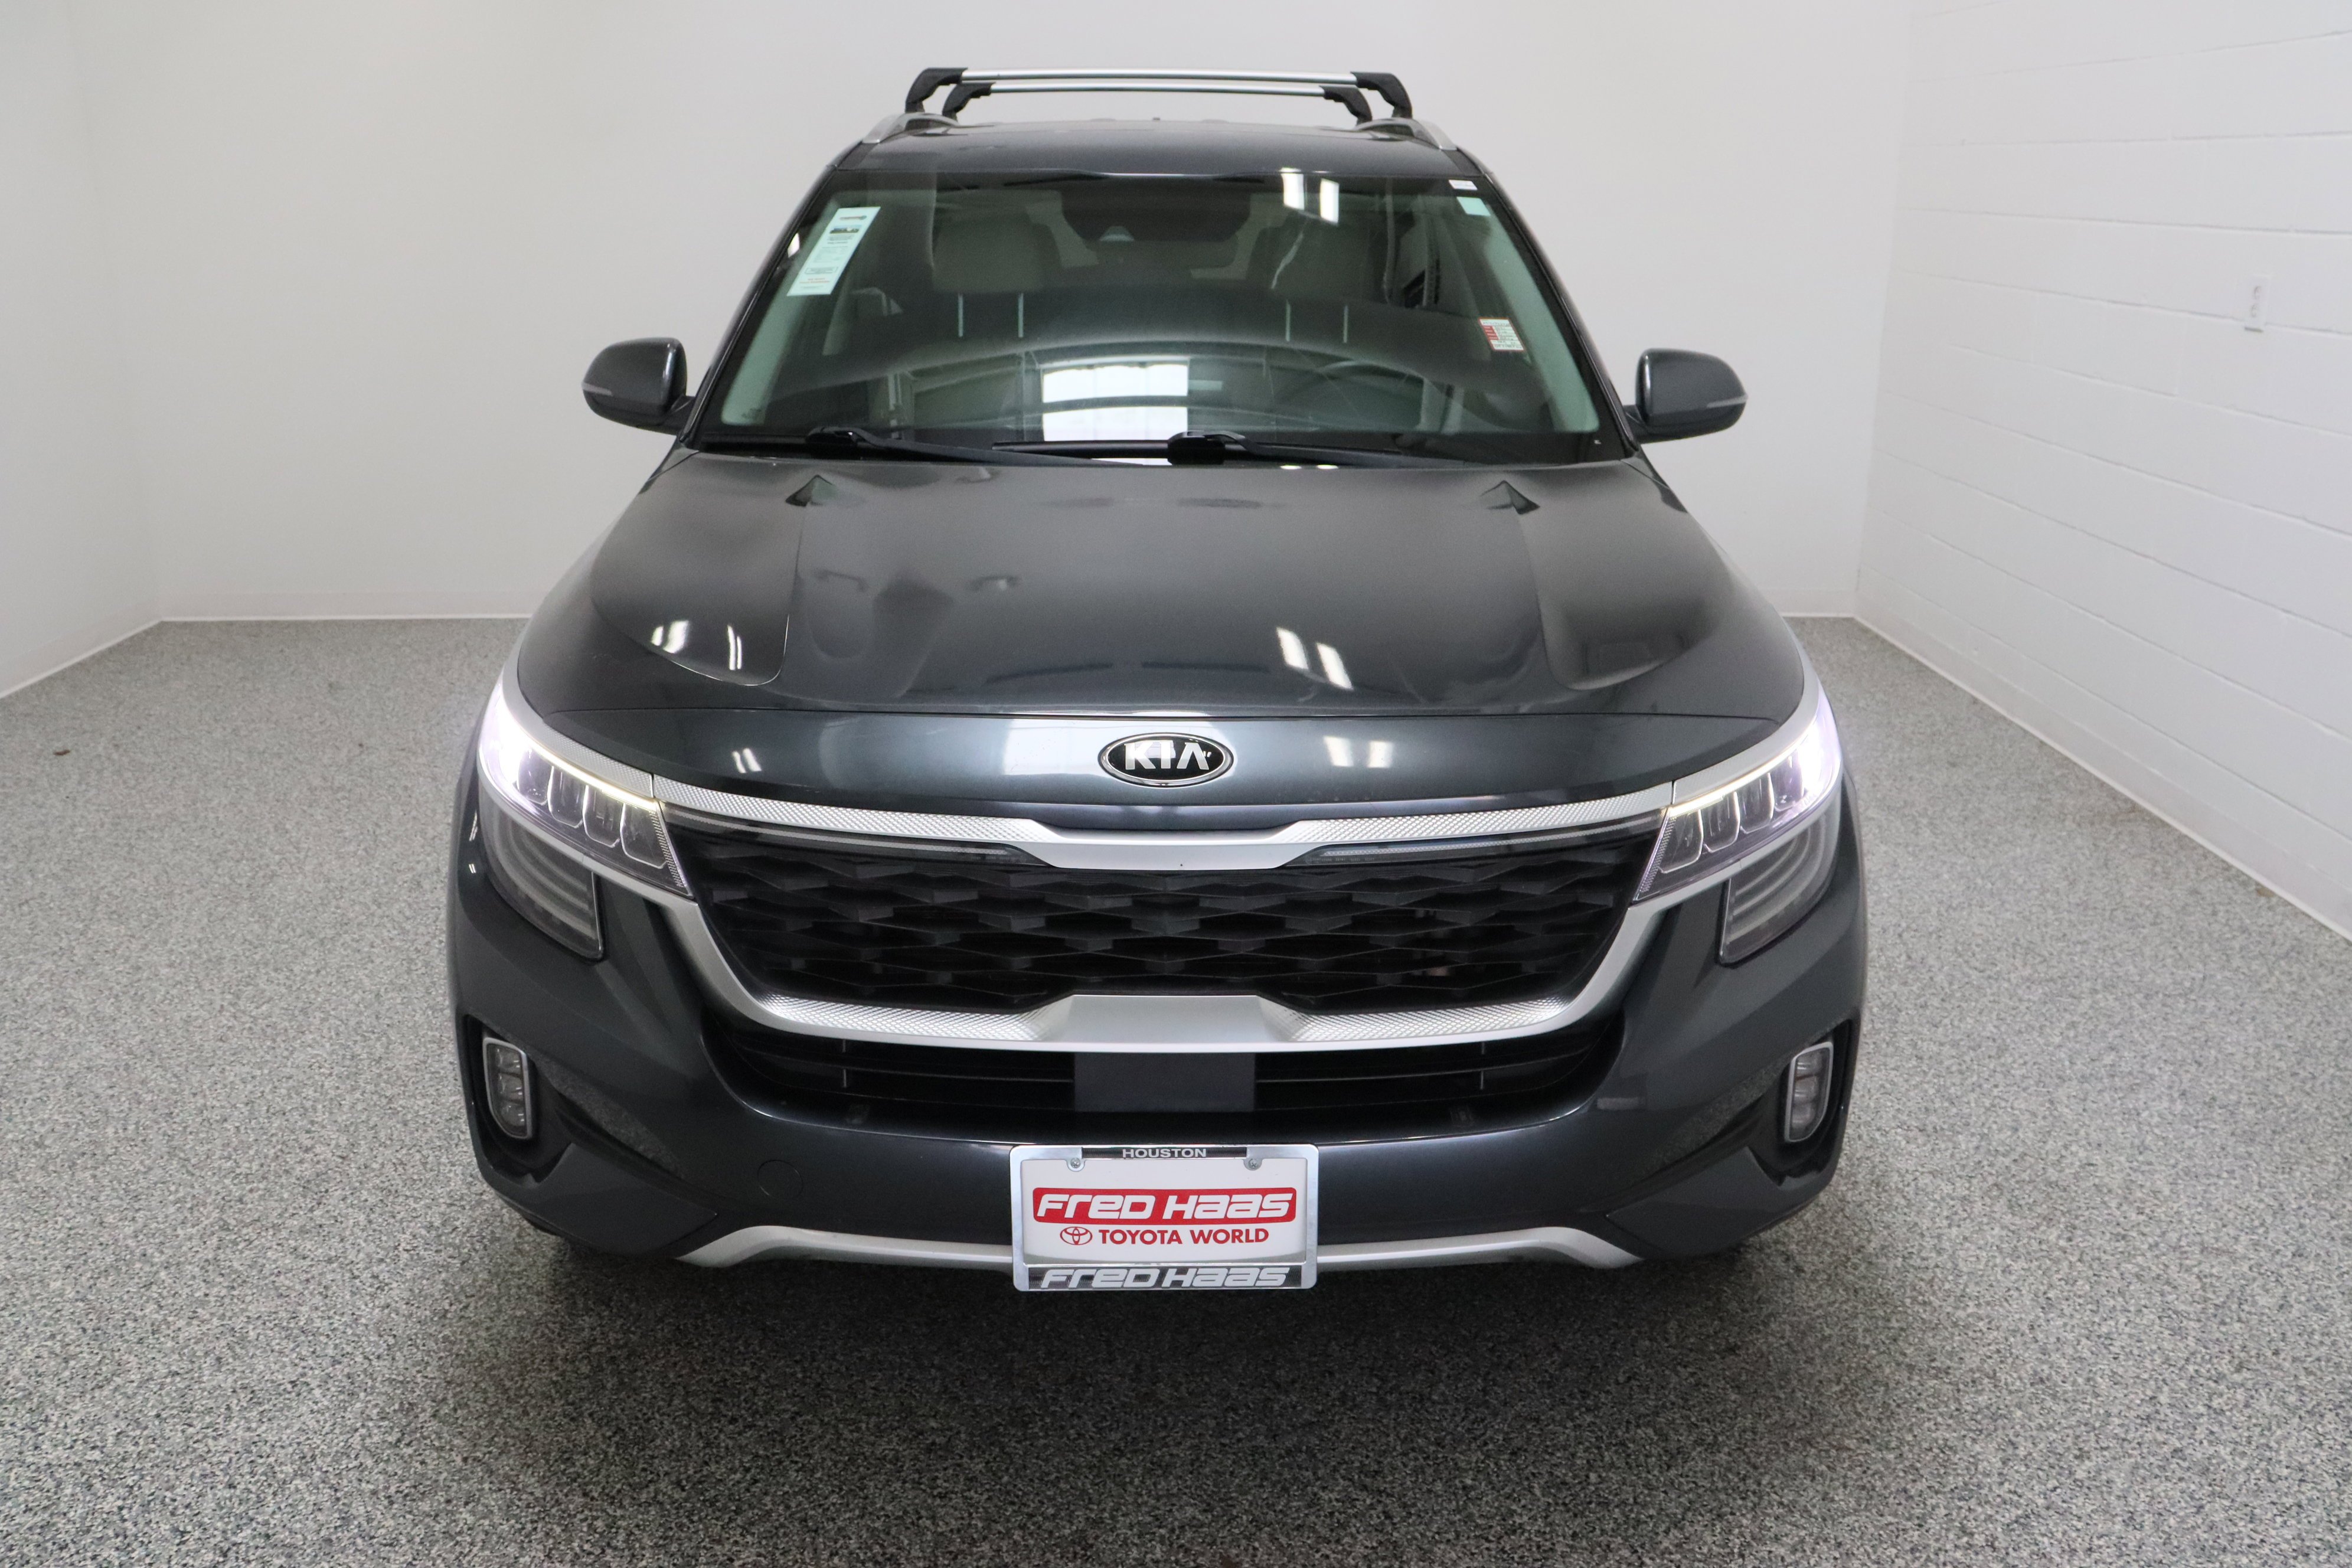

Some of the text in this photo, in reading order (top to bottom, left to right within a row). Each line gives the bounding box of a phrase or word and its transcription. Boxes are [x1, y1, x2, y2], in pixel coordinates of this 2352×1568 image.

[1123, 740, 1210, 770] KIA
[1122, 1148, 1207, 1158] HOUSTON
[1099, 1228, 1270, 1246] TOYOTA WORLD
